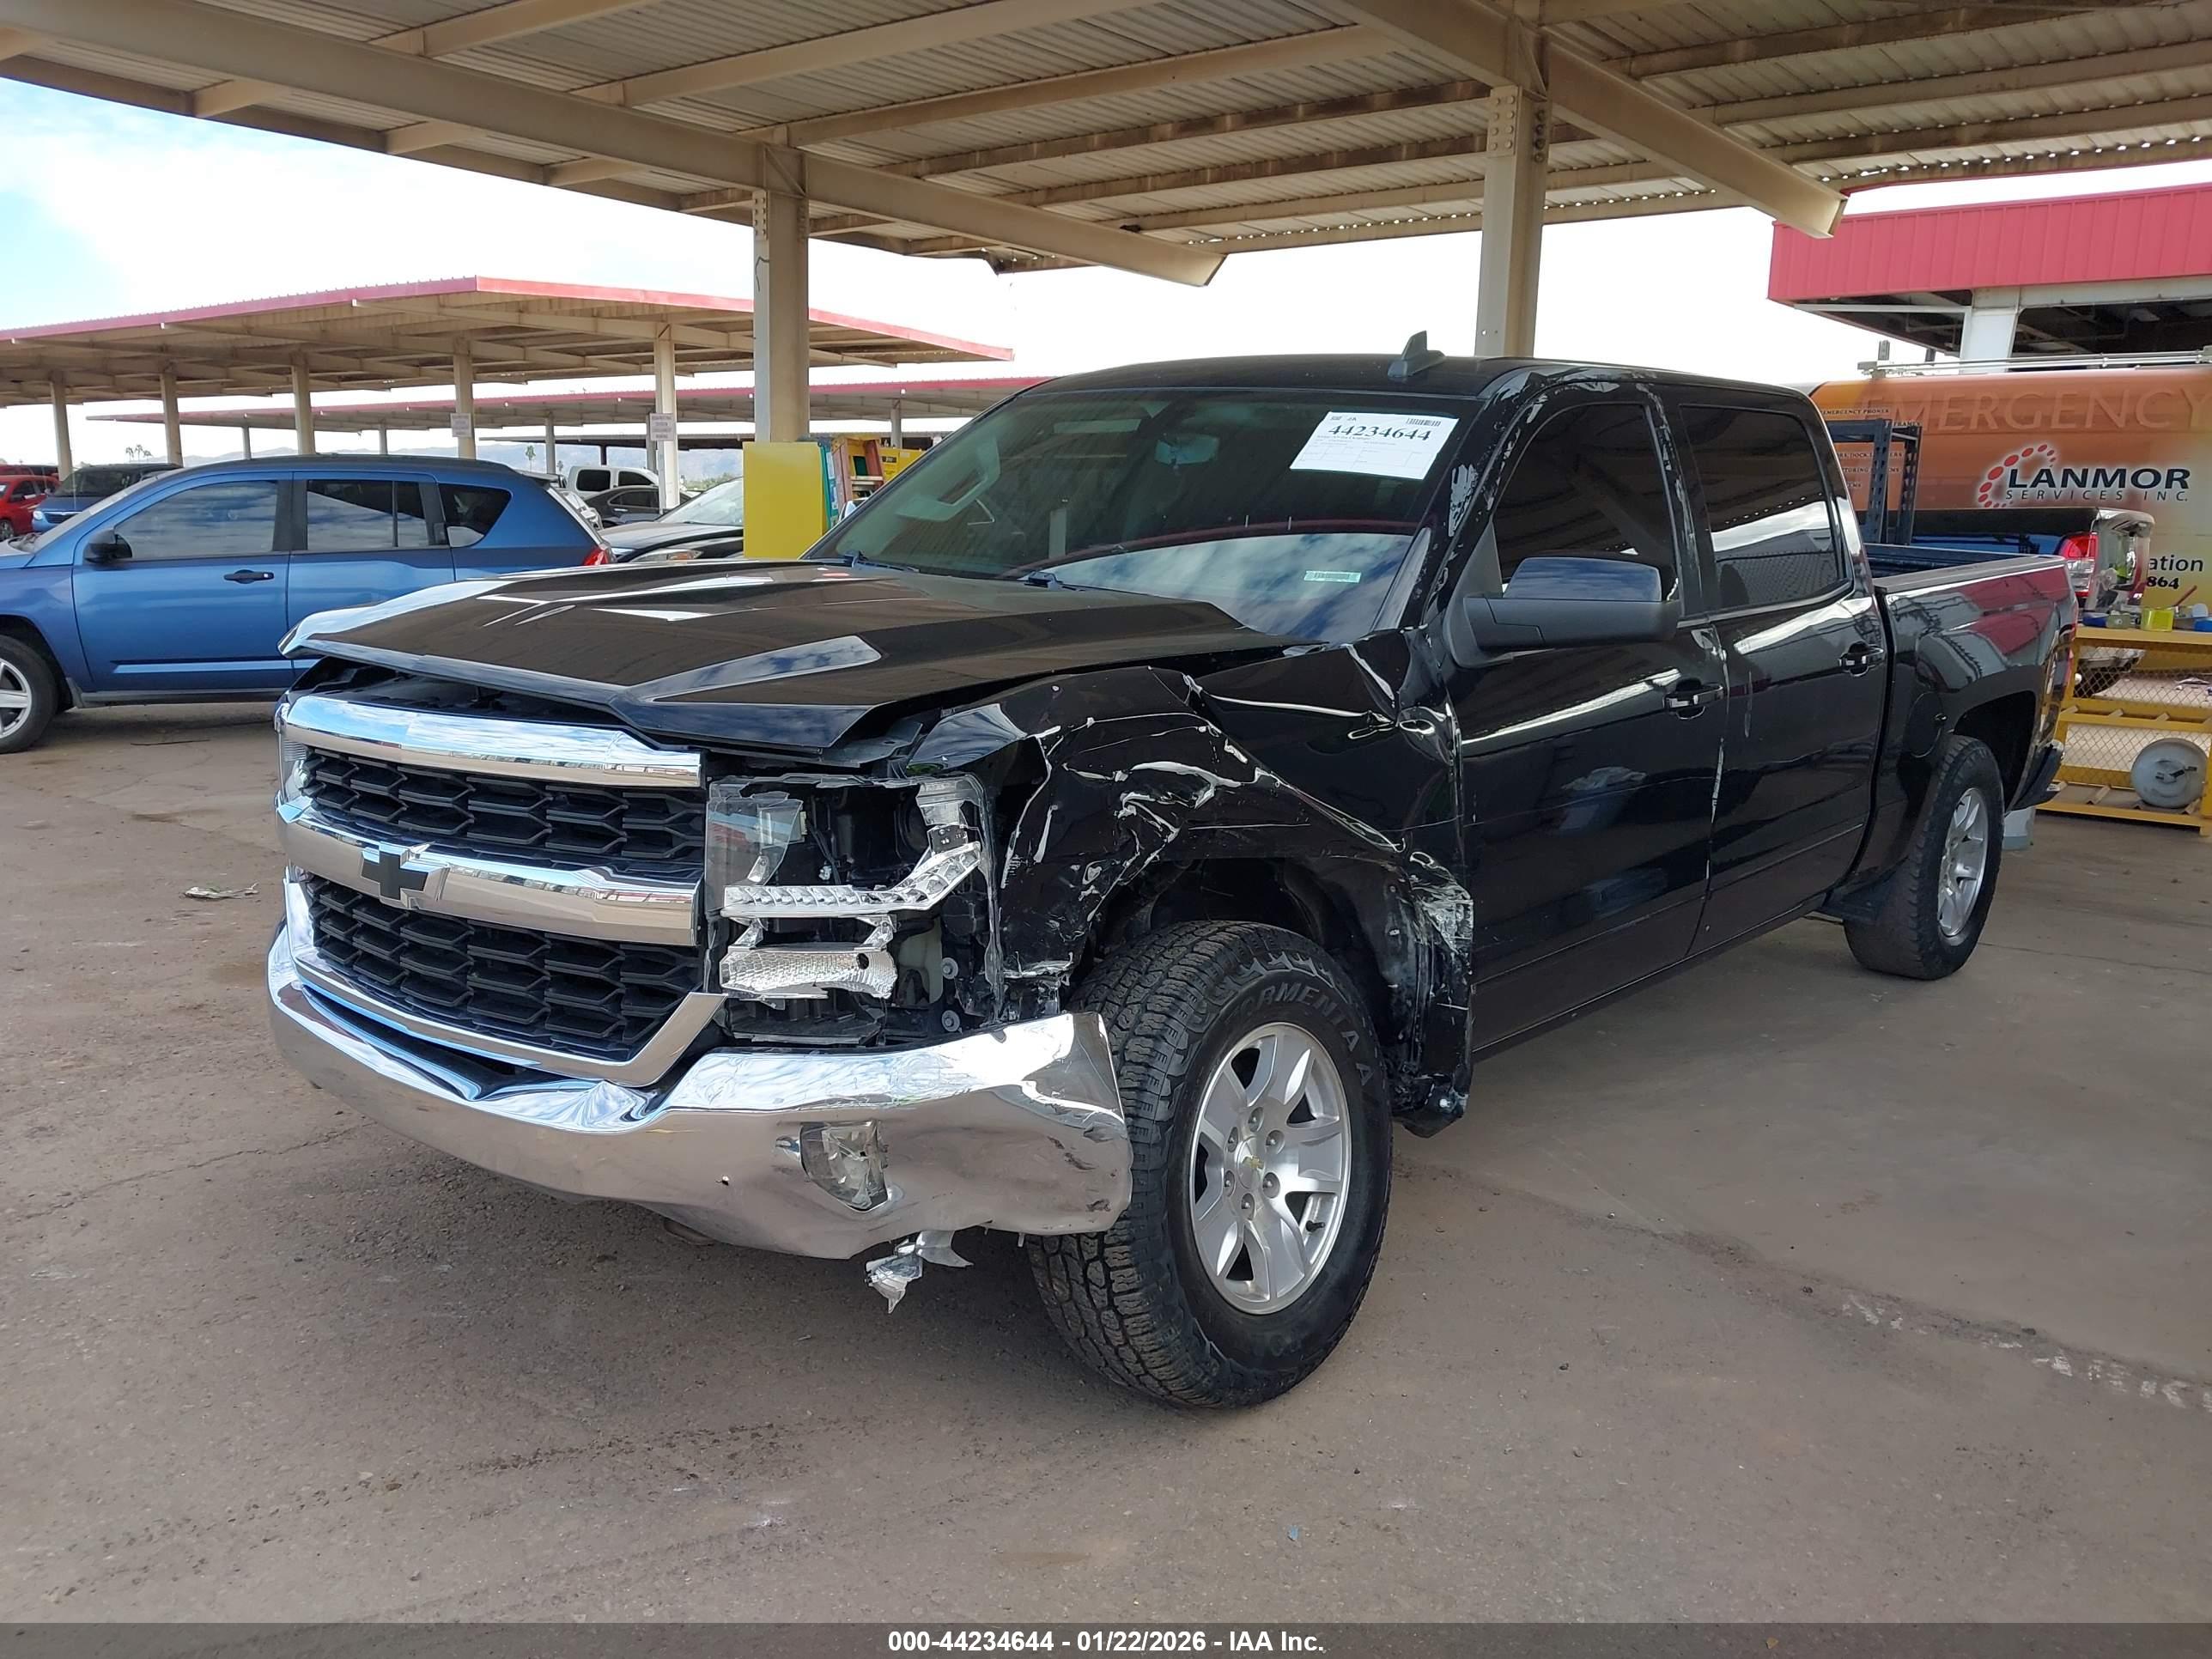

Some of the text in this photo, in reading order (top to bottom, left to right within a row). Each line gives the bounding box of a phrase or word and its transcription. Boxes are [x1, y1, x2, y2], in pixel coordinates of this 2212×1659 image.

[1861, 389, 2212, 430] EMERGENCY
[1328, 424, 1433, 441] 44234644
[2008, 468, 2190, 489] LANMOR
[2005, 489, 2189, 502] SERVICES INC.
[2149, 554, 2204, 572] ation
